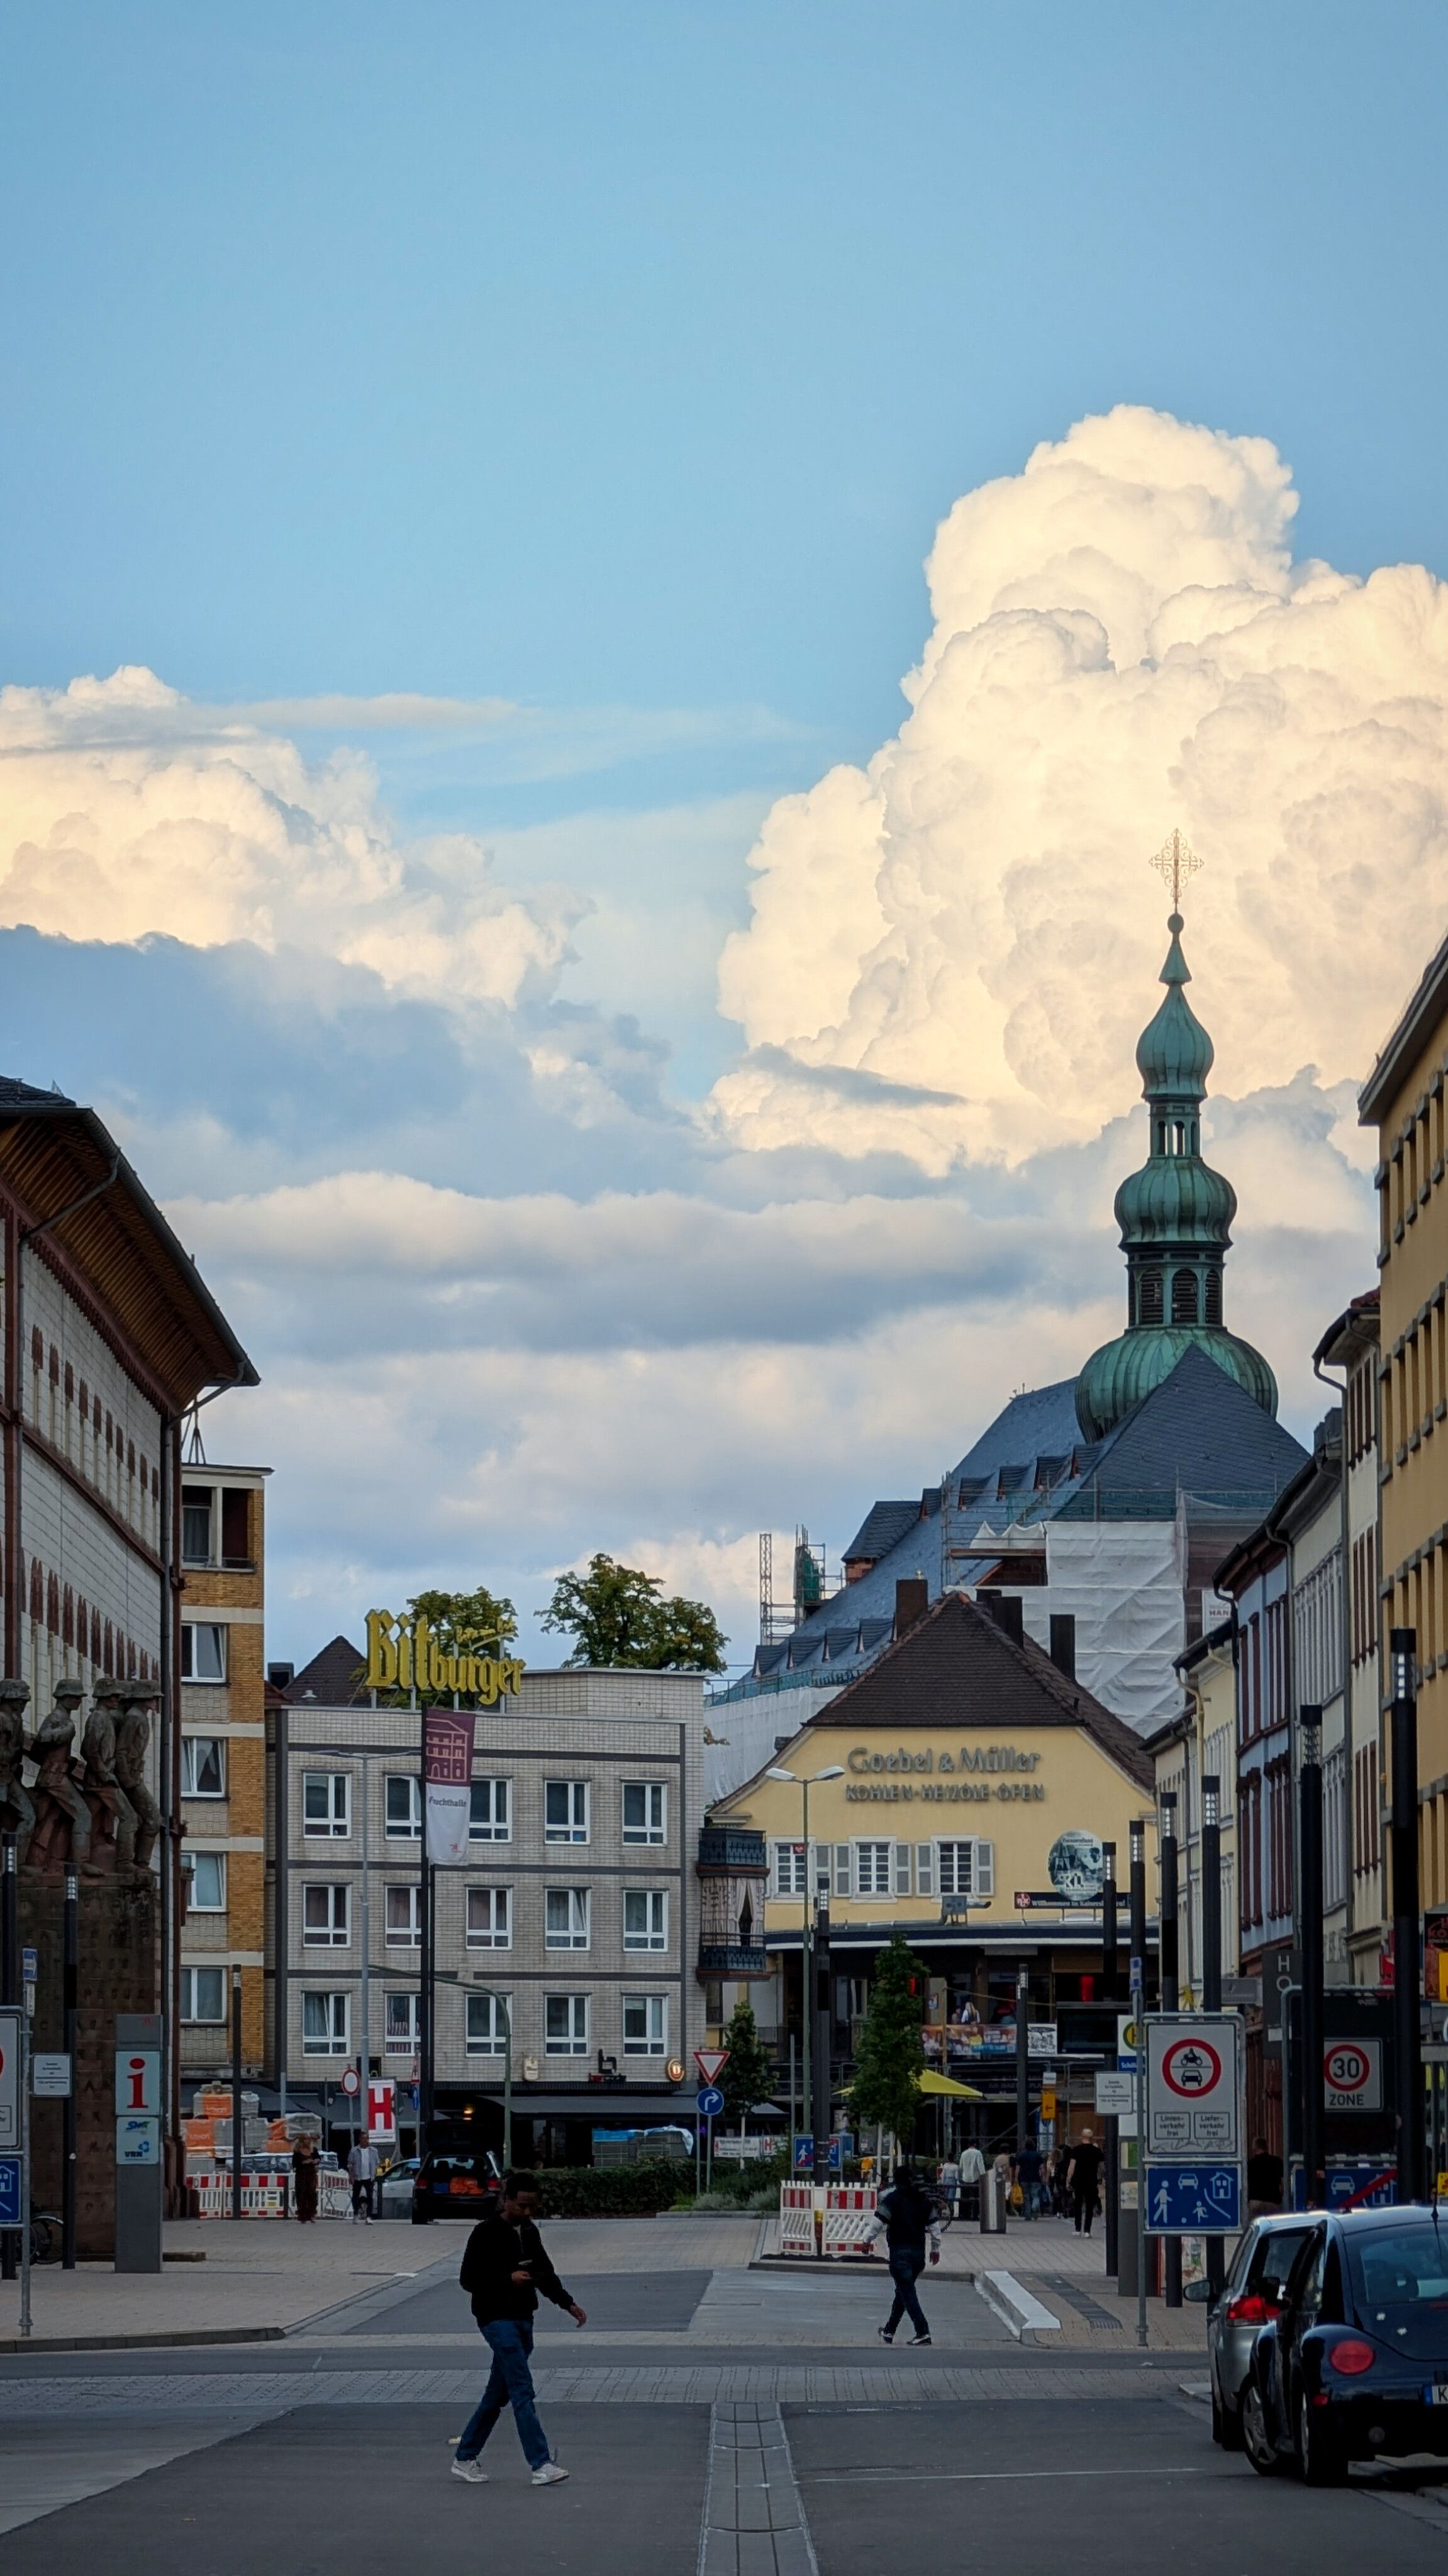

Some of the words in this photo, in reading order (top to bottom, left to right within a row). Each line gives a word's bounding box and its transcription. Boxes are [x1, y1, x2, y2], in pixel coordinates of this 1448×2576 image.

[365, 1608, 526, 1706] Bitburger
[848, 1746, 933, 1773] Goebel
[938, 1752, 955, 1773] &
[959, 1746, 1042, 1773] Müller
[1332, 2058, 1359, 2079] 30
[369, 2088, 392, 2130] H
[1329, 2094, 1364, 2106] ZONE
